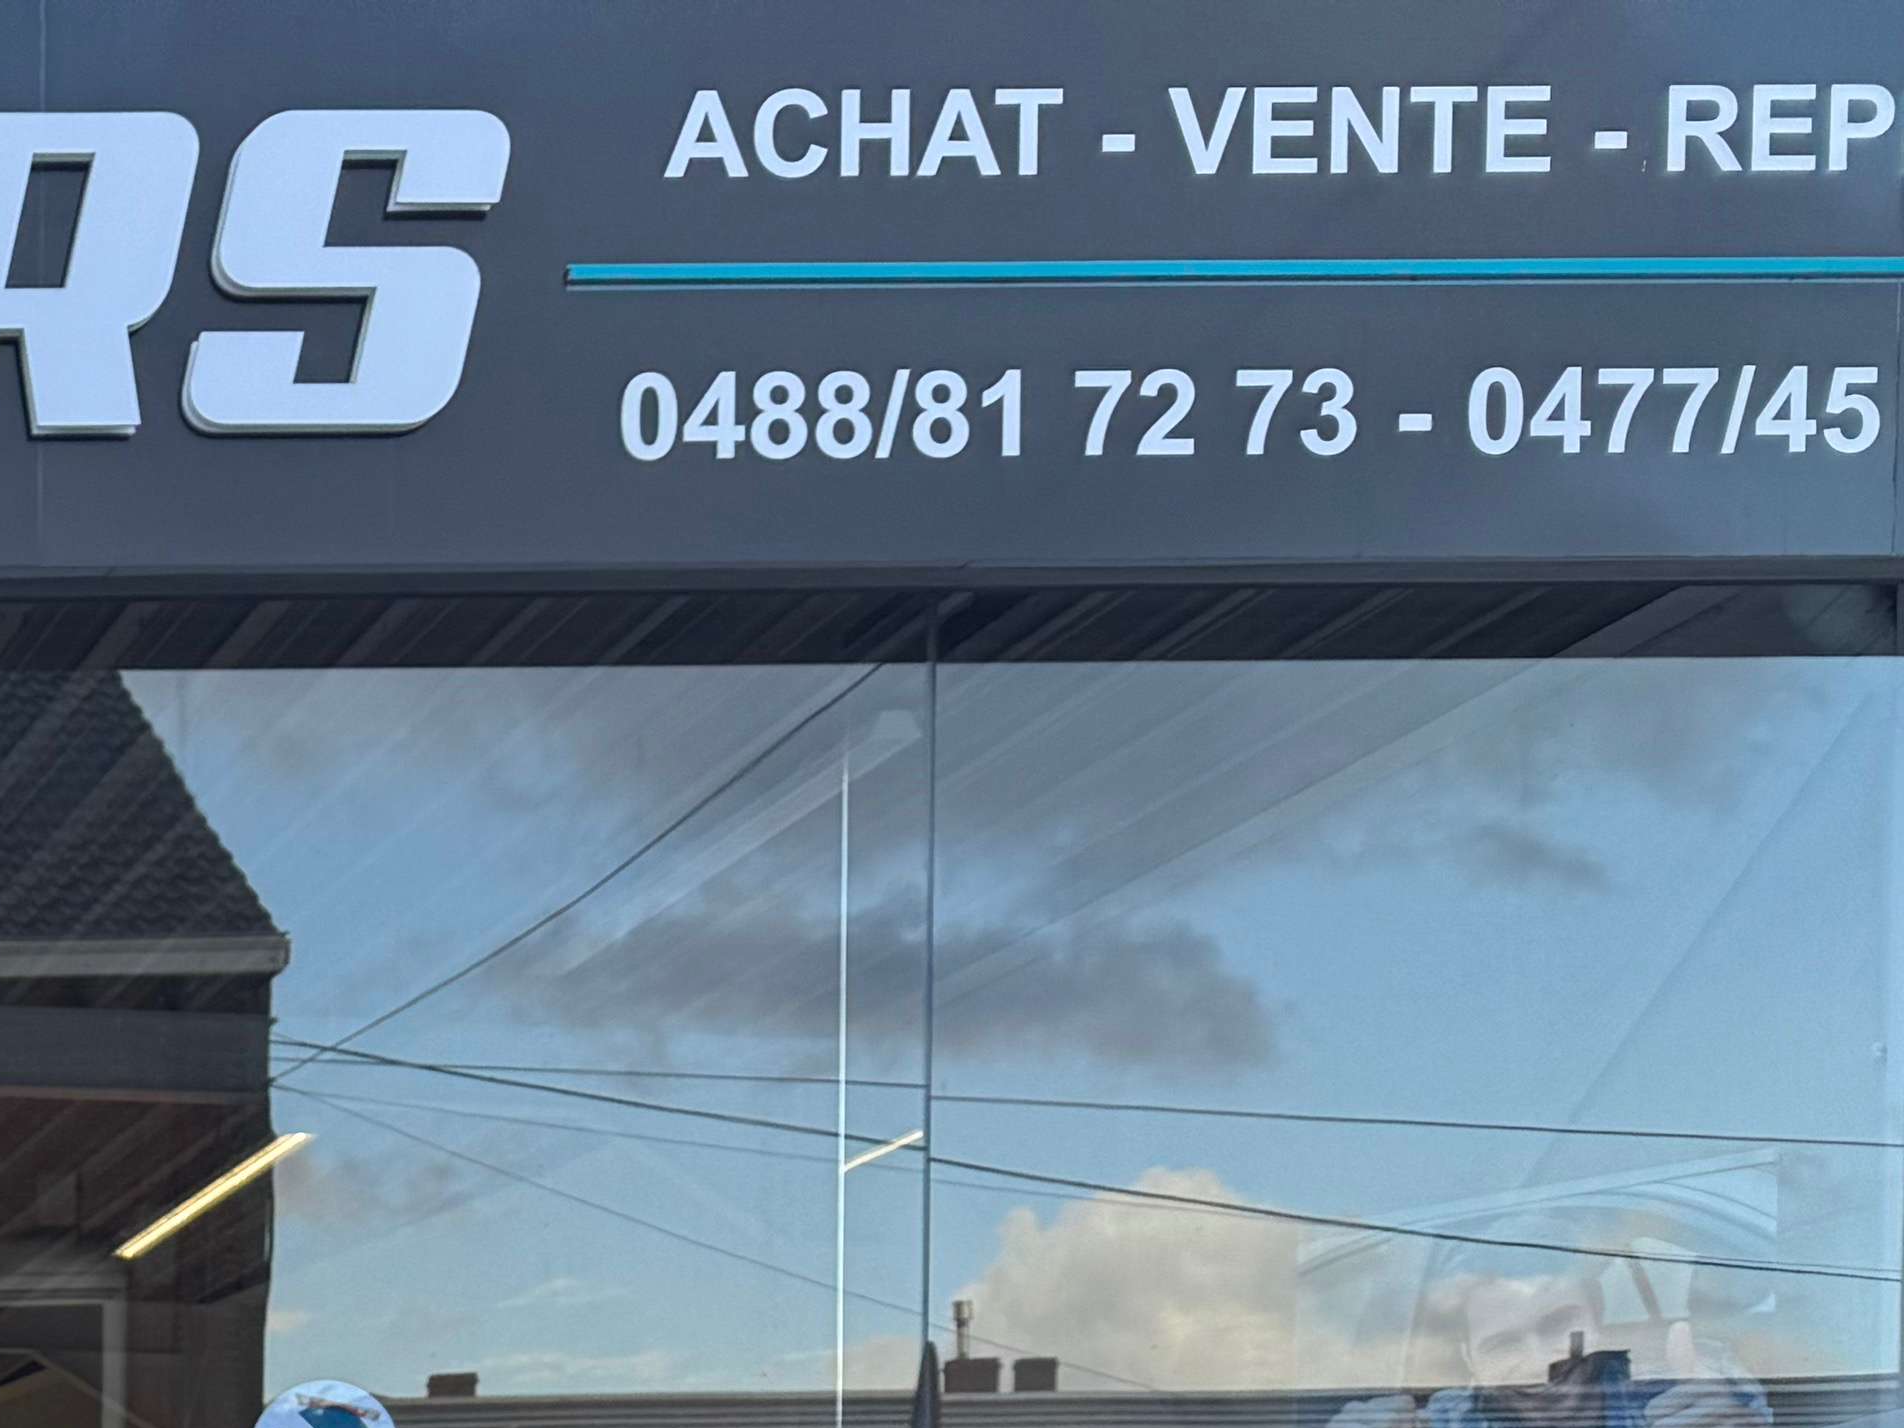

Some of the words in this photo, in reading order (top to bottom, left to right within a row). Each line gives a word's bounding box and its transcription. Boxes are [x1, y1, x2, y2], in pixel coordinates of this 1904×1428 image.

[664, 86, 1065, 180] ACHAT
[1101, 133, 1136, 154] -
[1168, 84, 1553, 176] VENTE
[1594, 130, 1629, 150] -
[1666, 82, 1896, 173] REP
[620, 367, 1022, 462] 0488/81
[1074, 367, 1196, 457] 72
[1235, 367, 1358, 457] 73
[1398, 413, 1433, 432] -
[1467, 364, 1882, 456] 0477/45
